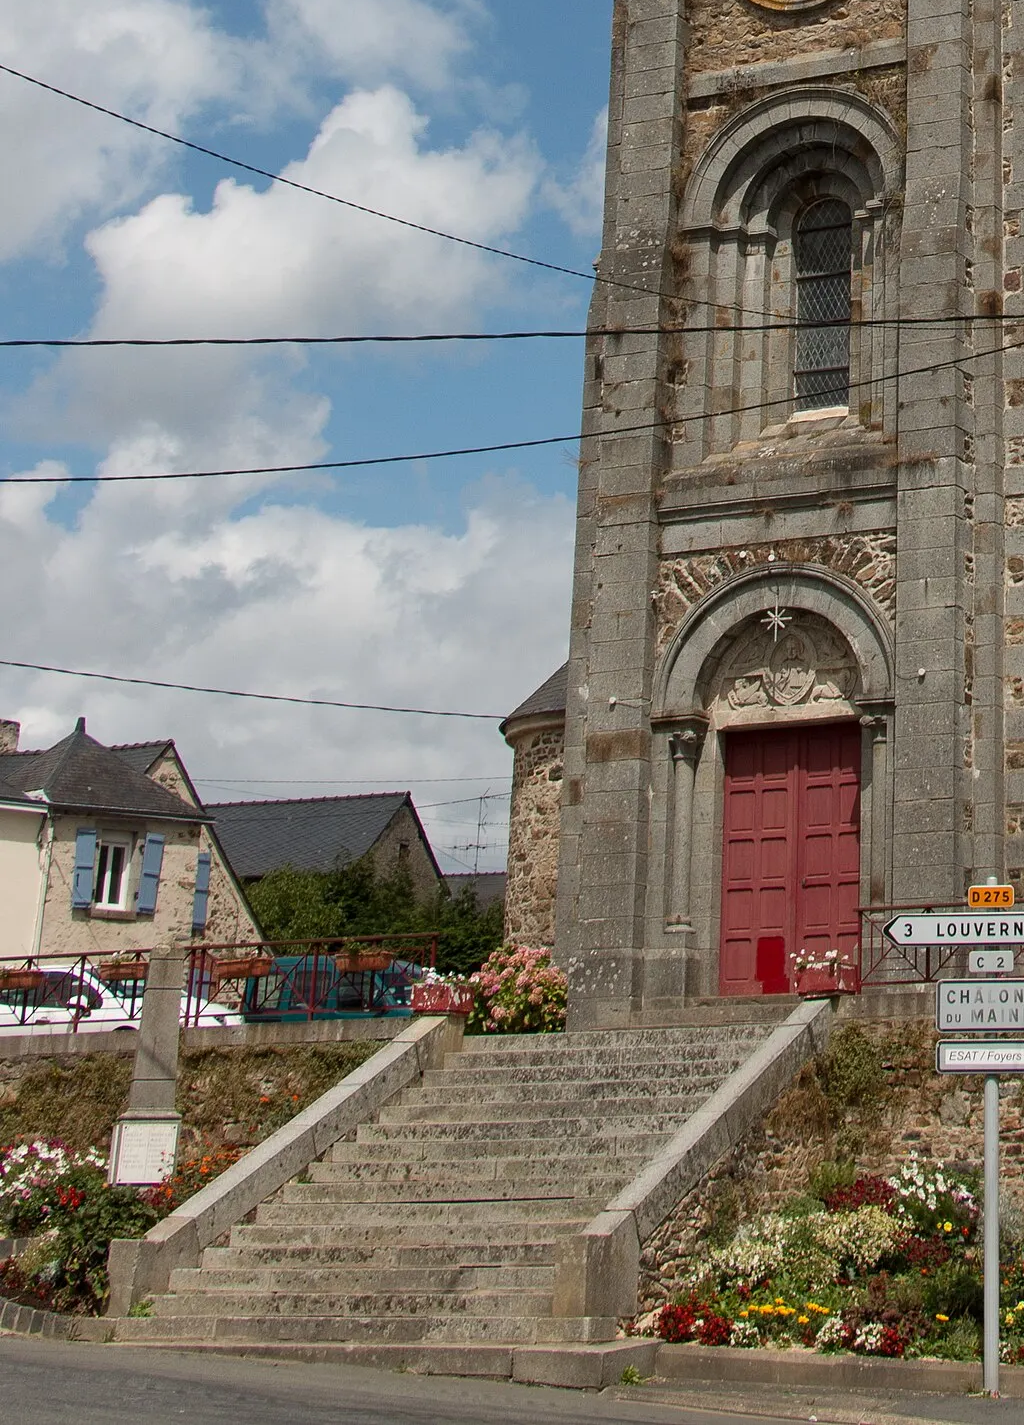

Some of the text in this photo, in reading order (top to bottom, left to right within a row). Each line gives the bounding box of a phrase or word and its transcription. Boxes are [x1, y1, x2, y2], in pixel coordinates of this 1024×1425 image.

[972, 891, 1010, 903] D 275
[904, 923, 913, 937] 3
[977, 956, 1005, 969] C 2
[946, 1013, 962, 1023] DU
[949, 1051, 978, 1061] ESAT
[980, 1050, 985, 1061] /
[987, 1050, 1022, 1063] Foyers
